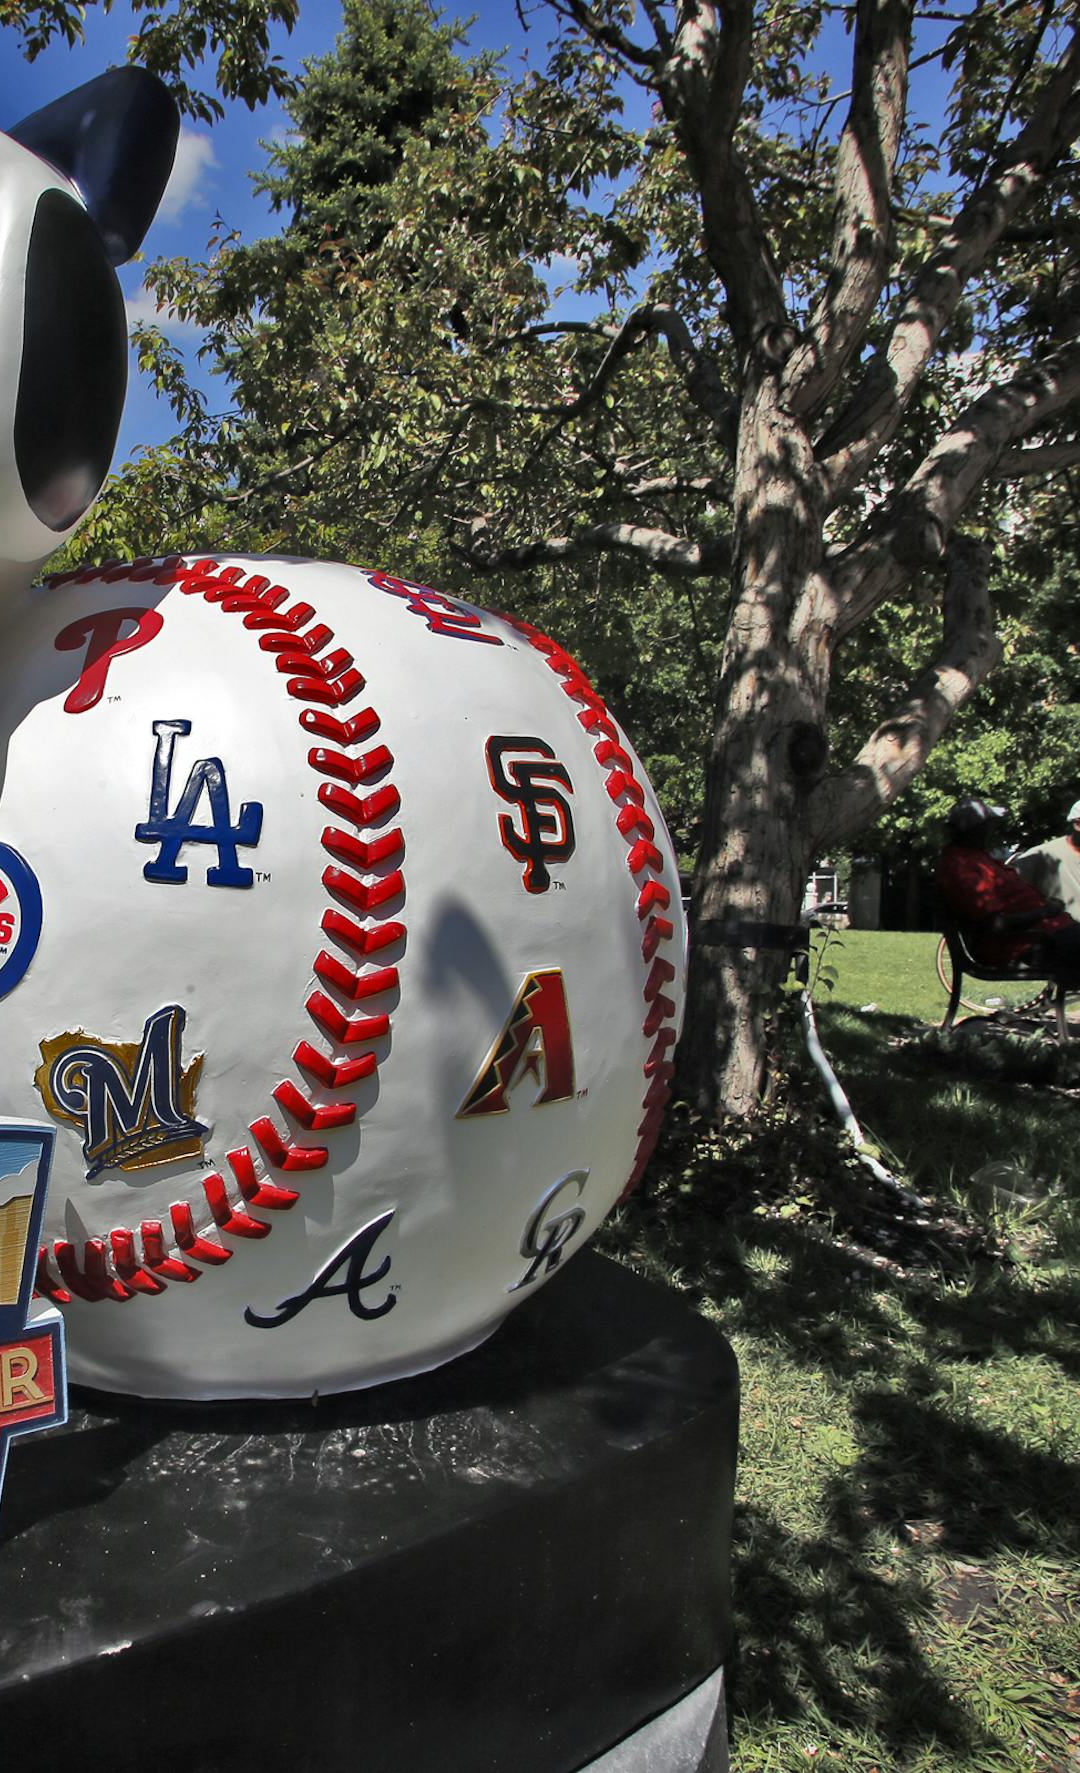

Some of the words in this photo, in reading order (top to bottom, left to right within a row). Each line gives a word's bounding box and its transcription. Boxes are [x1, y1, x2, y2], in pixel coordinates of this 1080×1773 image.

[54, 606, 164, 714] P
[135, 719, 263, 888] LA
[256, 872, 271, 882] TM
[485, 735, 576, 894] SF
[50, 1003, 188, 1163] M
[244, 1207, 397, 1329] A
